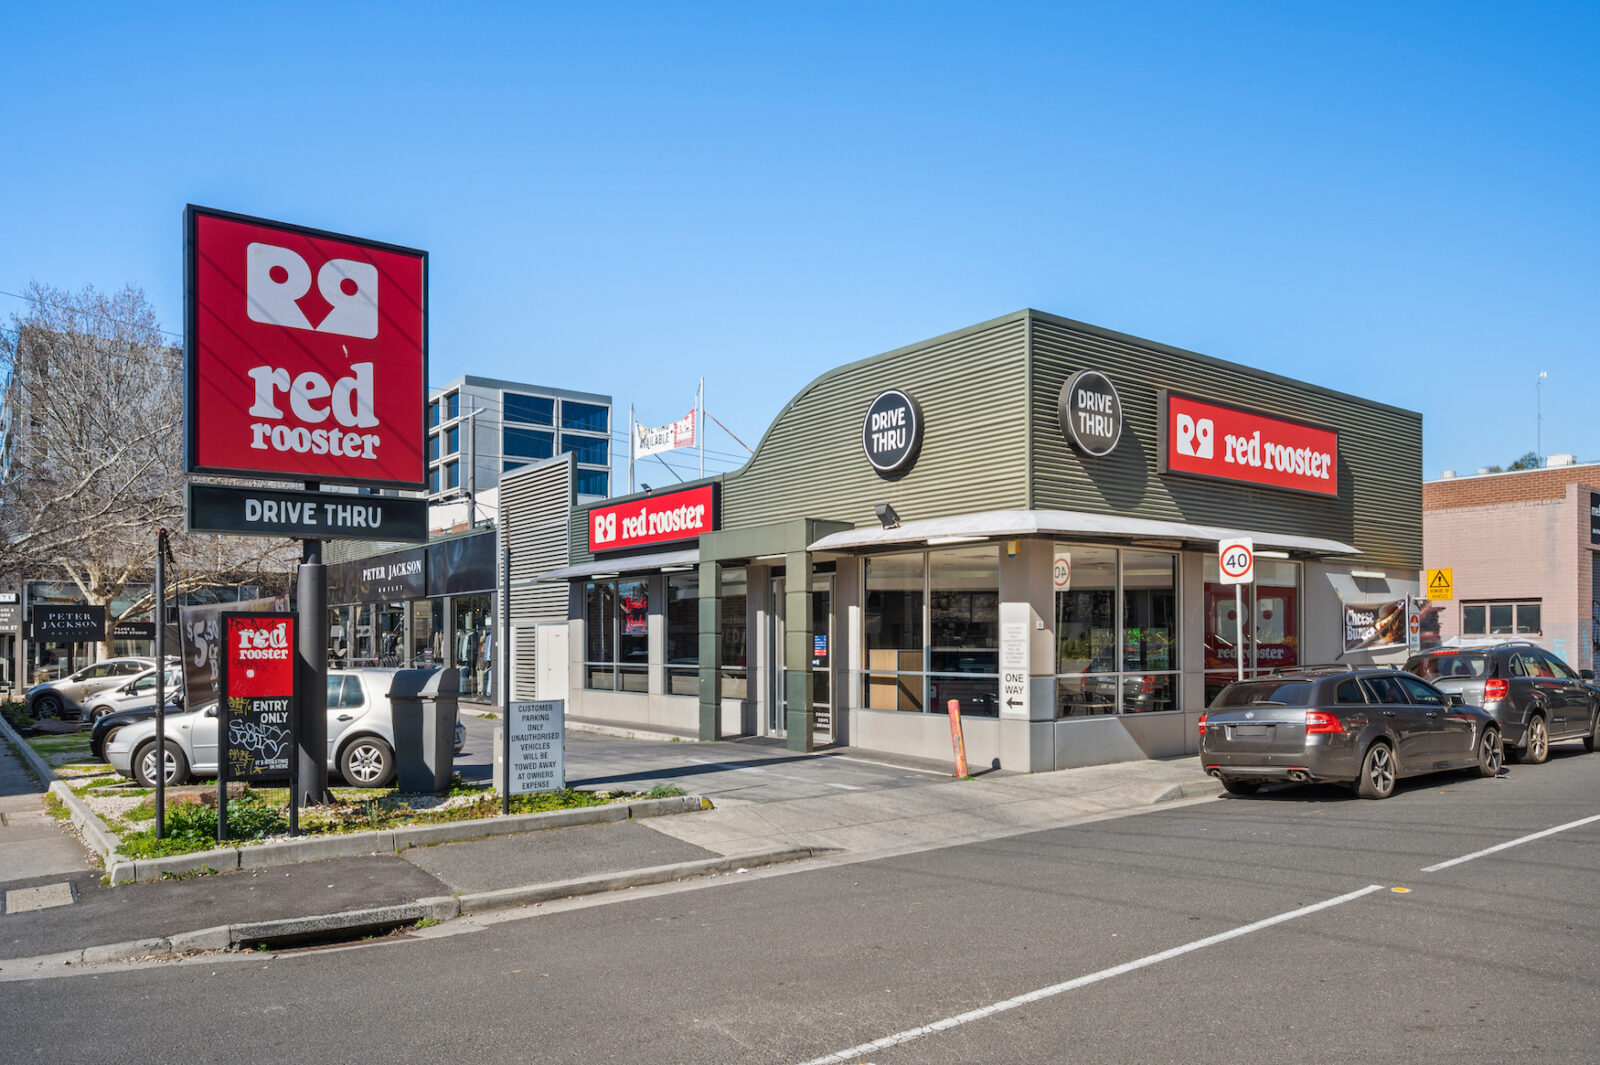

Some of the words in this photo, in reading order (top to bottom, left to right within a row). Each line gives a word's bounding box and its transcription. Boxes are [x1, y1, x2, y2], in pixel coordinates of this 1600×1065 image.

[248, 362, 380, 428] red
[1078, 388, 1113, 414] DRIVE
[872, 406, 906, 432] DRIVE
[1078, 411, 1113, 438] THRU
[250, 422, 381, 460] rooster
[871, 427, 906, 454] THRU
[1224, 430, 1262, 467] red
[1263, 442, 1331, 479] rooster
[245, 499, 317, 525] DRIVE
[324, 504, 382, 528] THRU
[622, 507, 647, 539] red
[648, 504, 705, 535] rooster
[1226, 553, 1247, 568] 40
[363, 566, 386, 581] PETER
[388, 560, 422, 581] JACKSON
[1346, 608, 1375, 626] Cheese
[41, 621, 97, 630] JACKSON
[238, 622, 288, 649] red
[239, 649, 289, 660] rooster
[1005, 673, 1024, 683] ONE
[1005, 686, 1024, 694] WAY
[253, 700, 288, 711] ENTRY
[518, 704, 553, 713] CUSTOMER
[260, 712, 288, 724] ONLY
[522, 714, 549, 722] PARKING
[511, 732, 560, 742] UNAUTHORISED
[520, 742, 550, 751] VEHICLES
[540, 752, 548, 760] BE
[514, 762, 537, 771] TOWED
[539, 761, 557, 769] AWAY
[527, 771, 554, 779] OWNERS
[522, 780, 550, 790] EXPENSE
